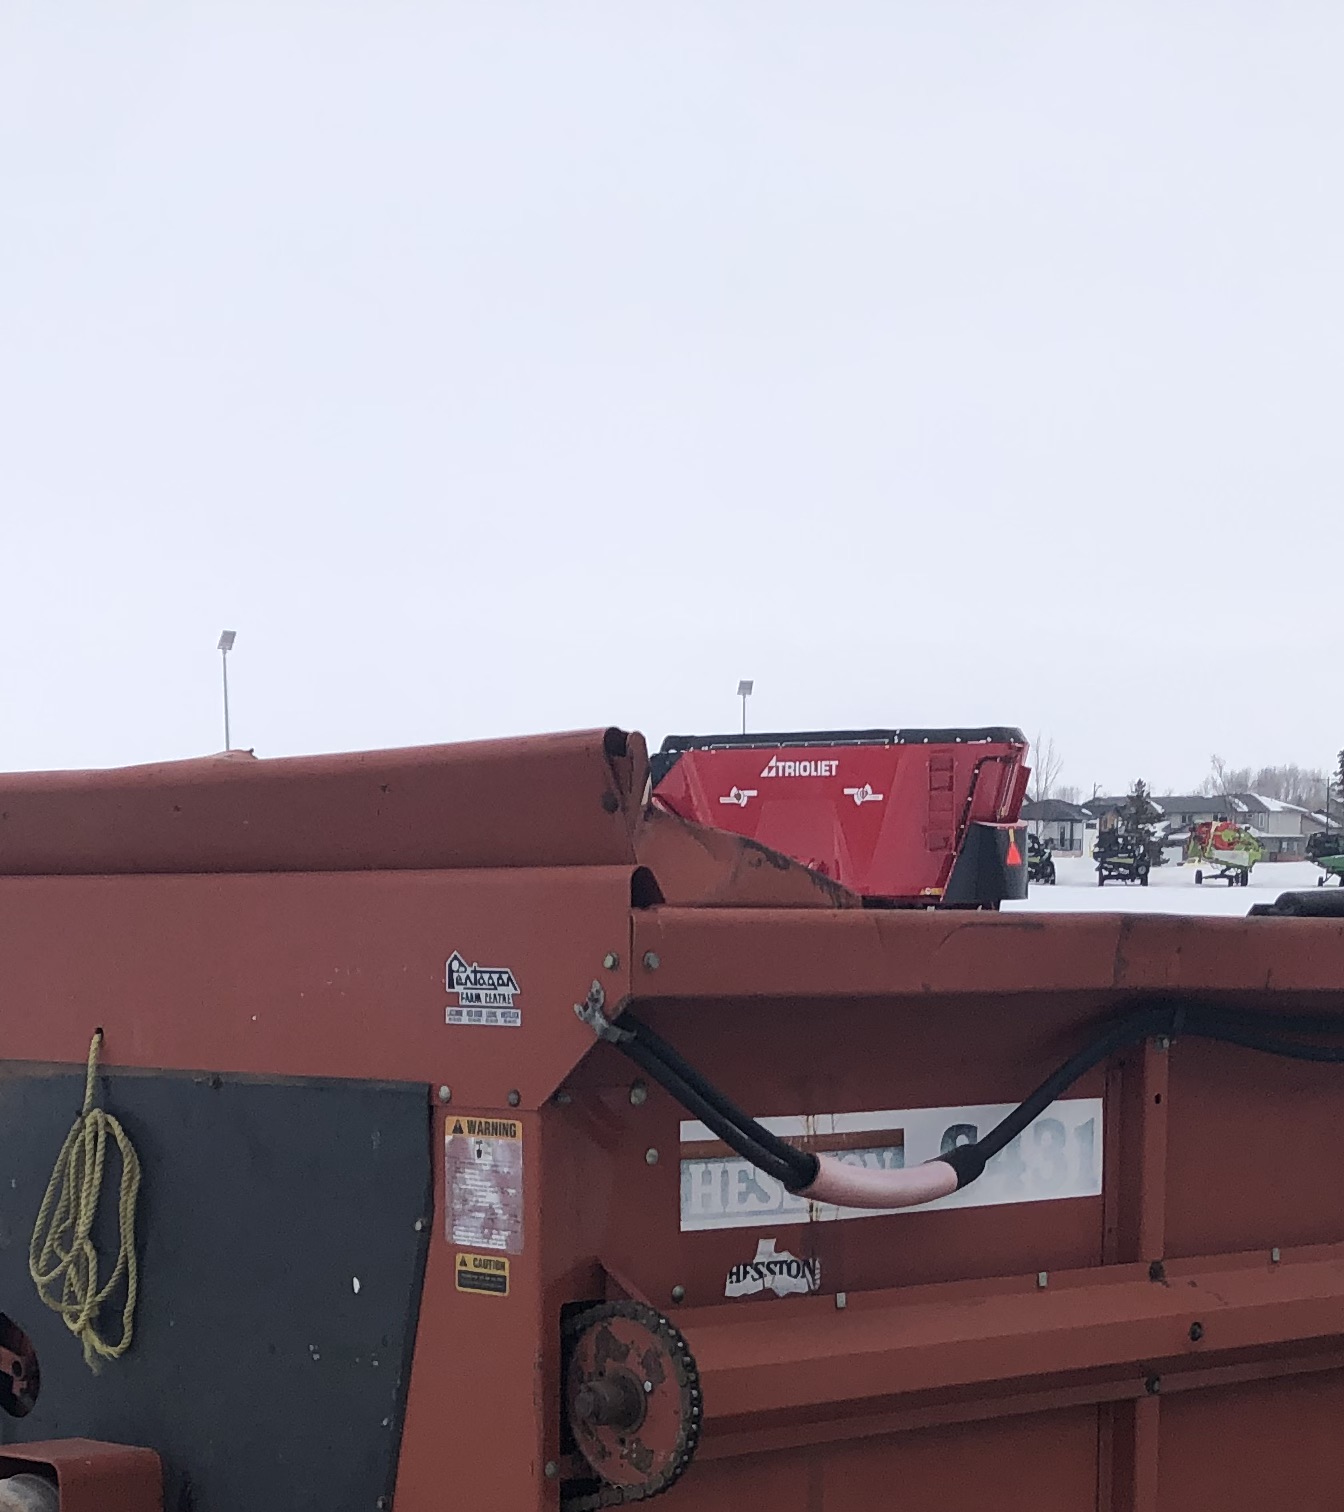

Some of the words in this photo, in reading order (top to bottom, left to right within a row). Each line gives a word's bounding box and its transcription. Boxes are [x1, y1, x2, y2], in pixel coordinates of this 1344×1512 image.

[777, 760, 839, 777] TRIOLIET
[448, 954, 518, 991] Pentagon
[467, 1119, 517, 1138] WARNING
[473, 1257, 506, 1272] CAUTION
